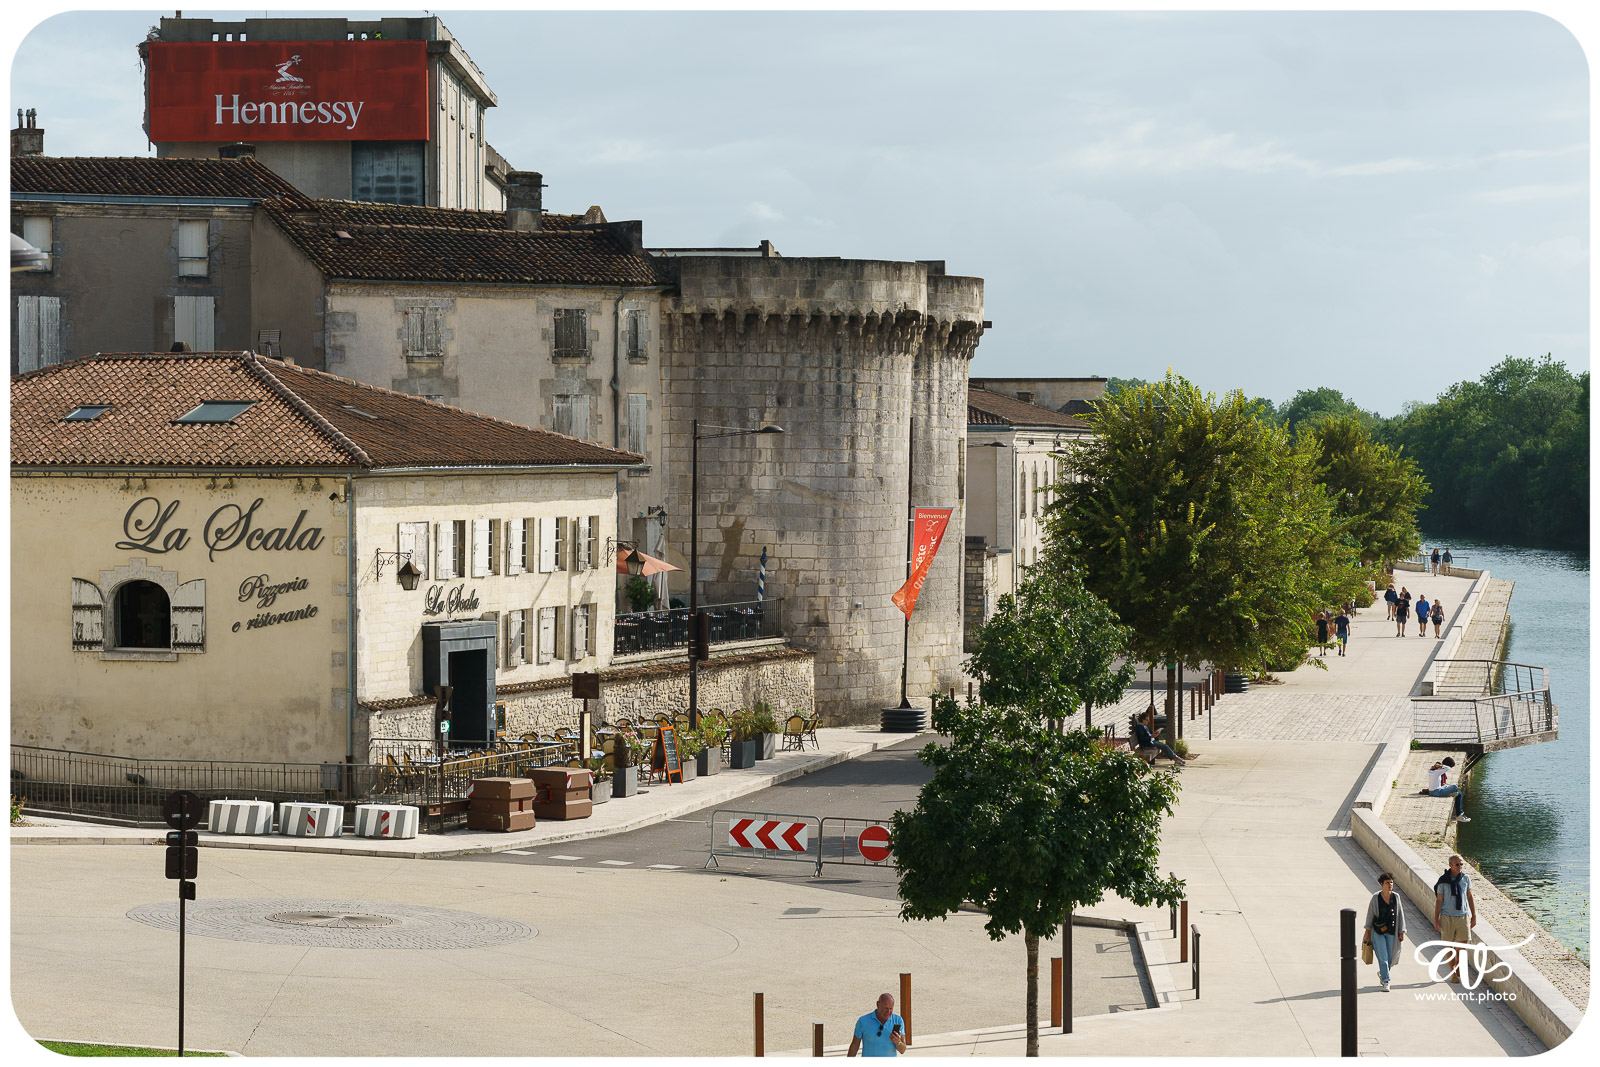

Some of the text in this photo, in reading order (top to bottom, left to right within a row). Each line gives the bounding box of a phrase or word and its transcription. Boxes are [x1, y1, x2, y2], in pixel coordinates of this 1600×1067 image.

[214, 94, 364, 130] Hennessy
[115, 496, 325, 563] La Scala
[238, 573, 309, 609] Pizzeria
[422, 583, 480, 619] La Scala
[231, 603, 318, 633] e ristorante
